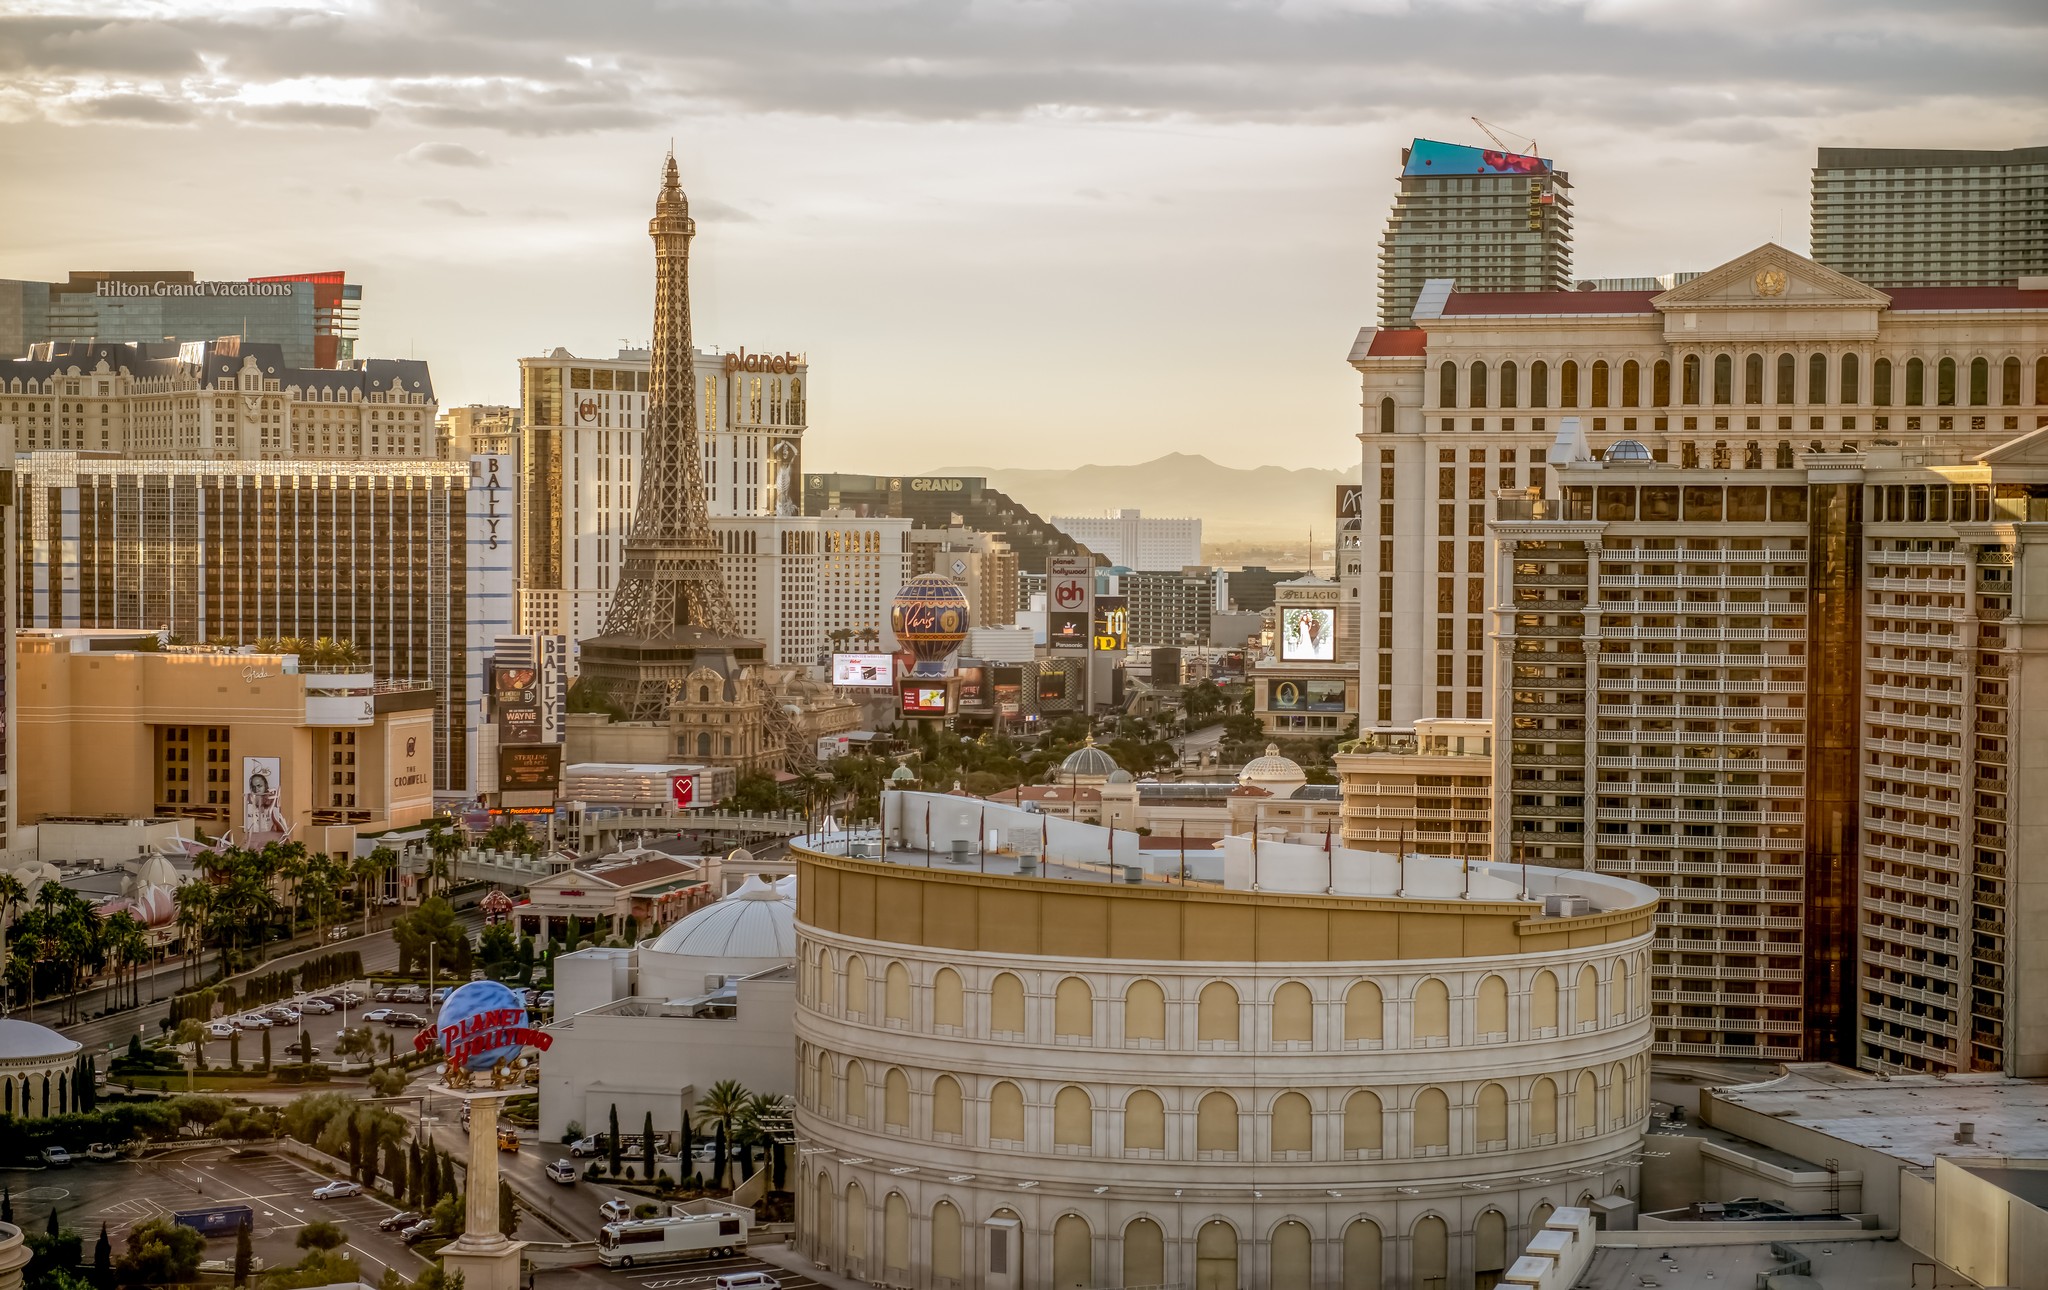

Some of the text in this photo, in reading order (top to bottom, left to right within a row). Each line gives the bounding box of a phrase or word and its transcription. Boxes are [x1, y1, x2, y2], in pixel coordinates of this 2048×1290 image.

[96, 281, 292, 296] Hilton Grand Vacations
[726, 346, 797, 379] planet
[911, 479, 963, 491] GRAND
[487, 458, 500, 550] BALLYS
[1052, 558, 1075, 566] planet
[1056, 580, 1084, 607] ph
[1280, 590, 1338, 599] BELLAGIO
[905, 602, 935, 637] Paris
[543, 640, 556, 730] BALLYS
[441, 1009, 525, 1055] PLANET
